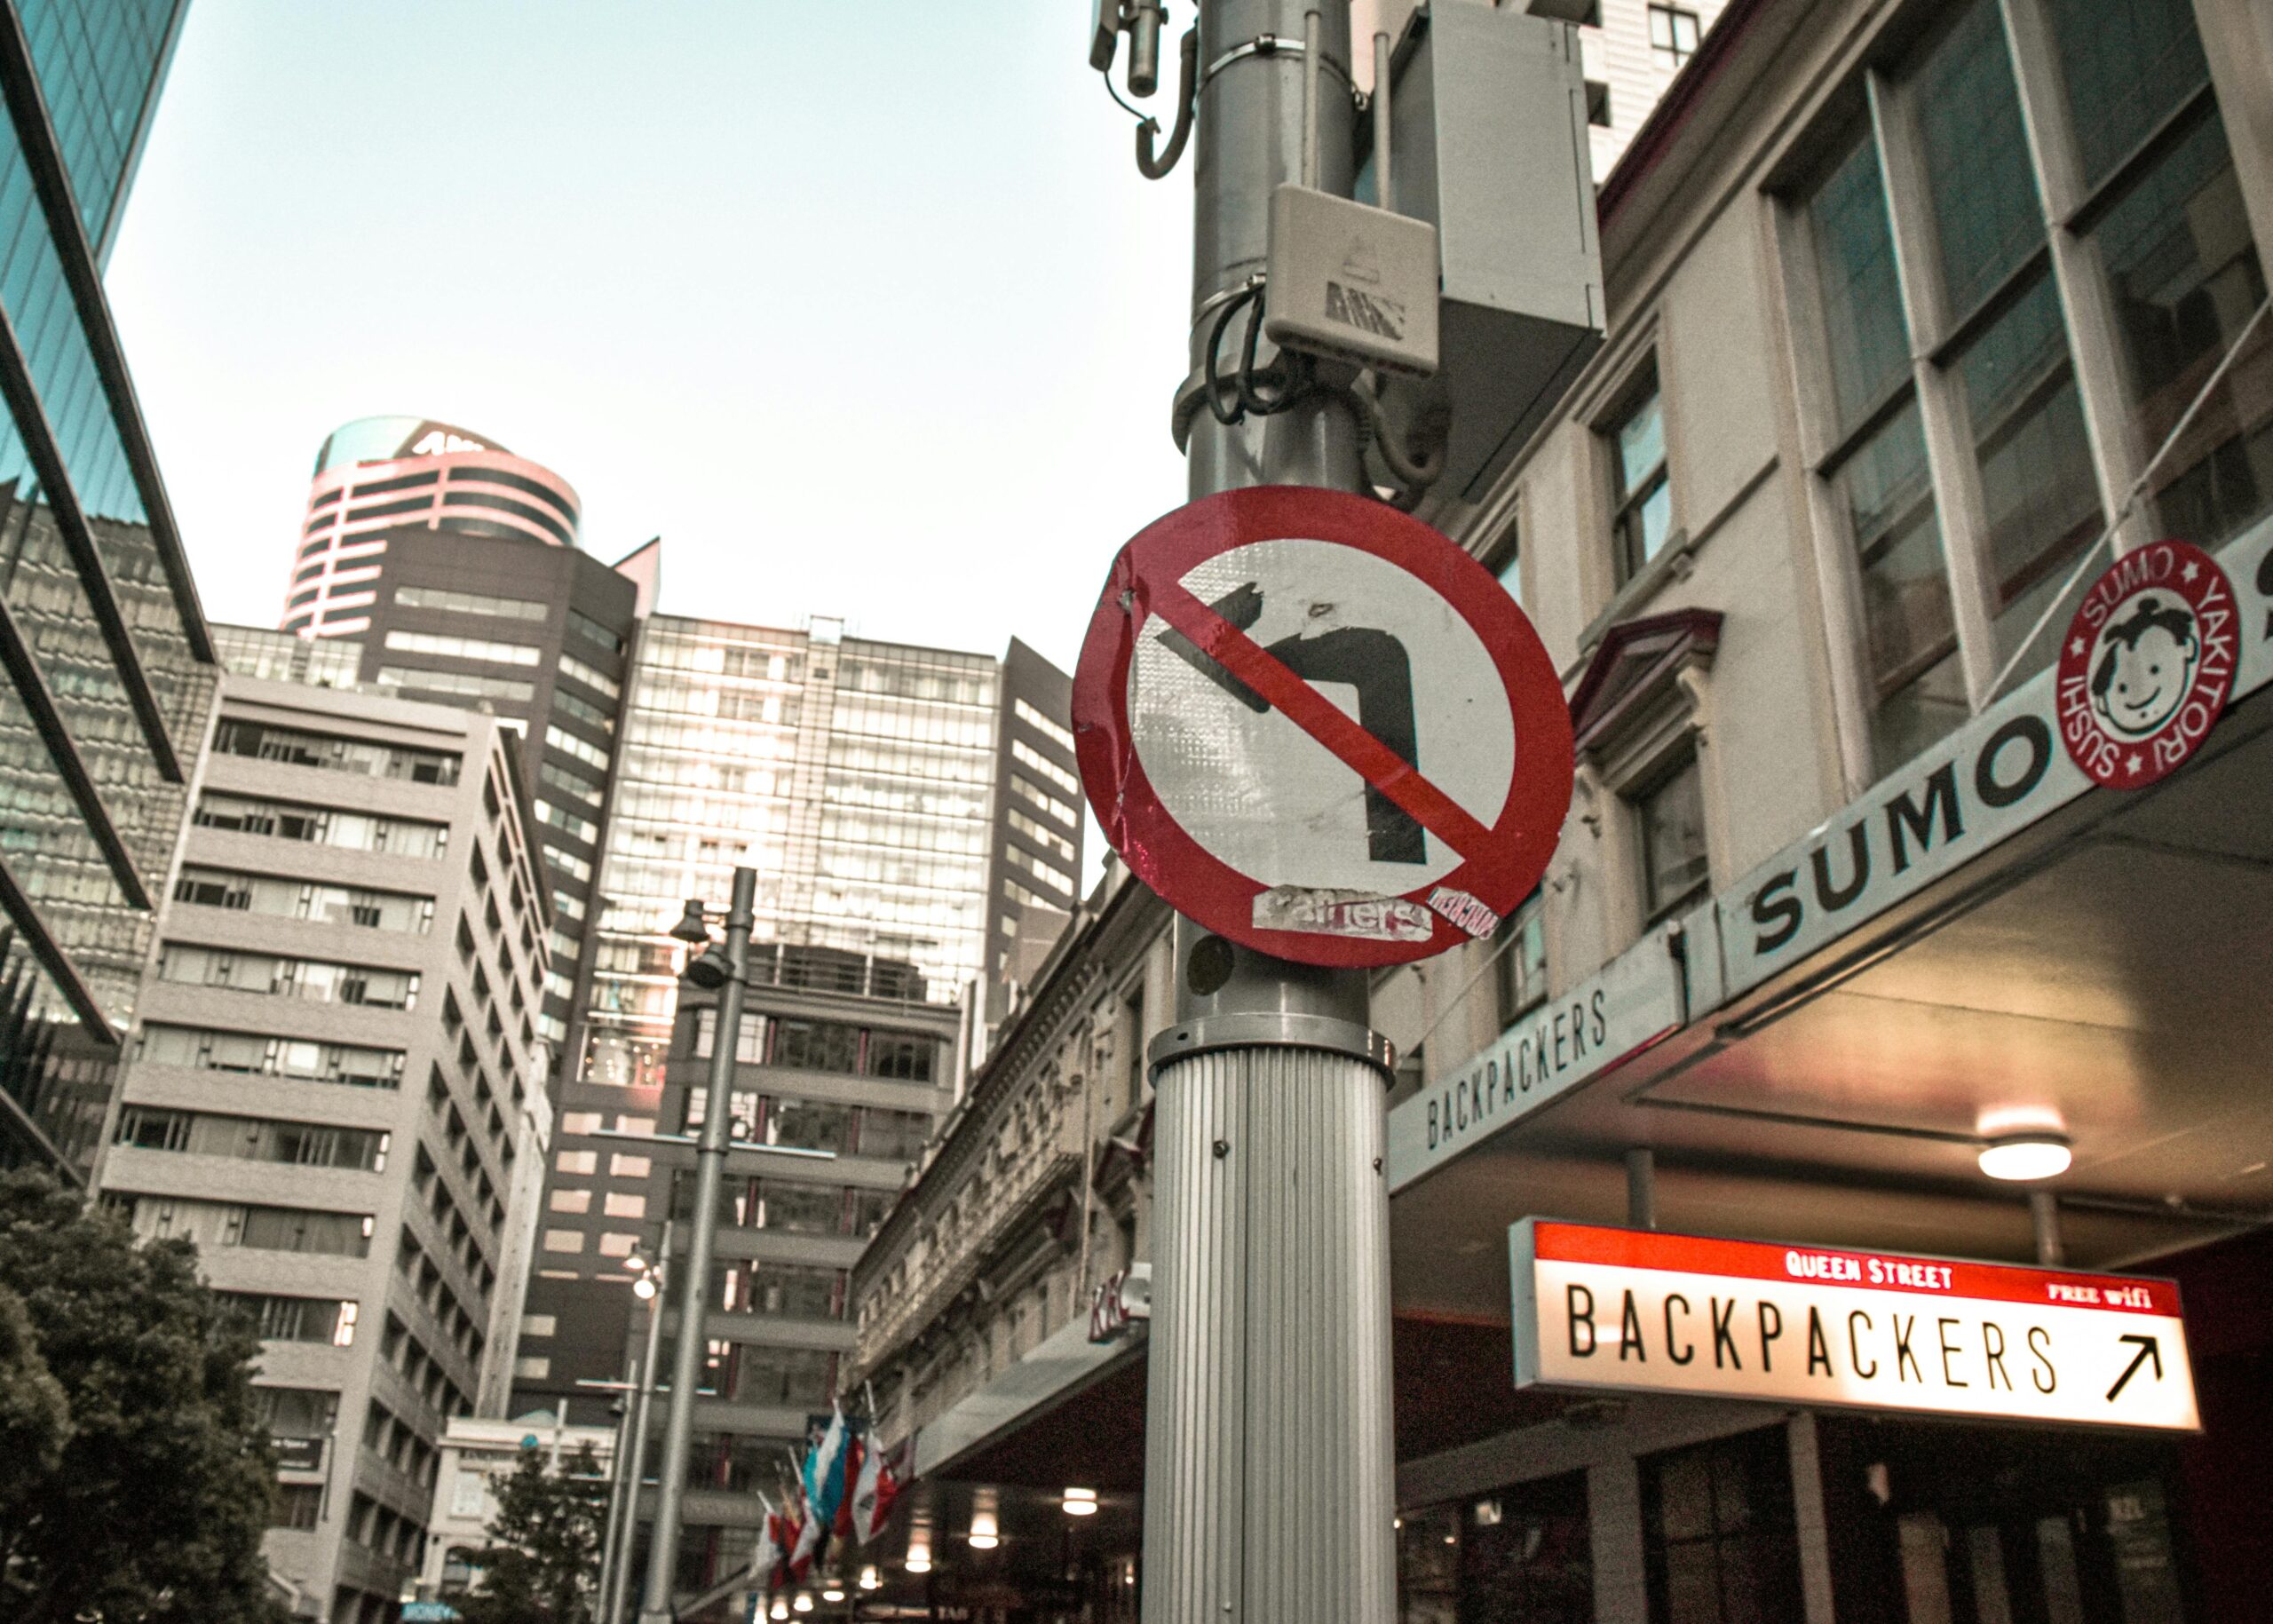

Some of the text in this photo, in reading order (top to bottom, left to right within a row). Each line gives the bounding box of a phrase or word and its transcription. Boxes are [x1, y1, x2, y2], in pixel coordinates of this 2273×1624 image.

[2062, 546, 2232, 777] SUMO YAKITORI SUSHI
[1752, 715, 2052, 955] SUMO
[1428, 989, 1605, 1150] BACKPACKERS
[1786, 1250, 1952, 1289] QUEEN STREET
[2047, 1284, 2101, 1303] FREE
[1566, 1284, 2056, 1394] BACKPACKERS
